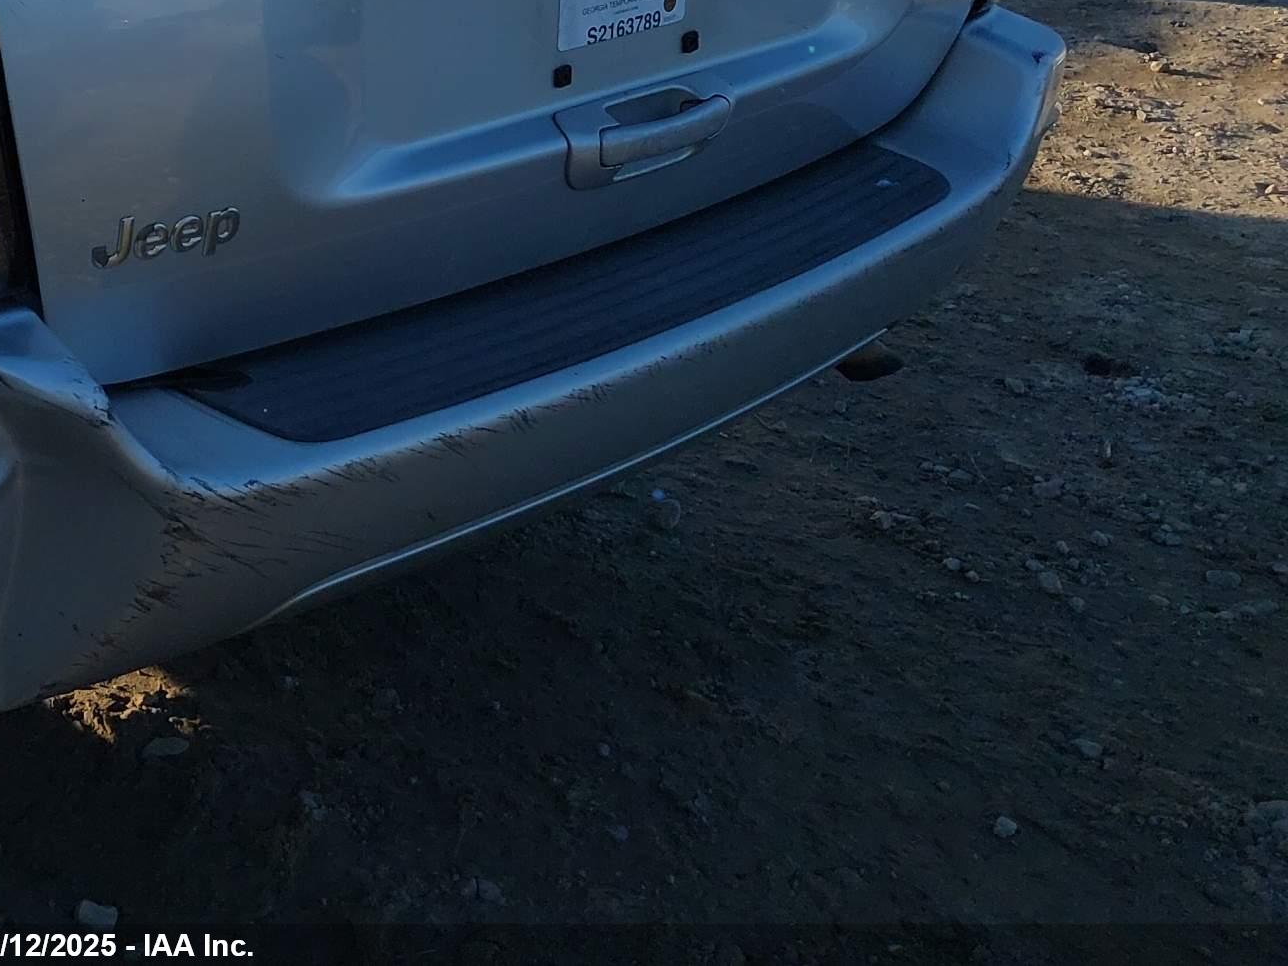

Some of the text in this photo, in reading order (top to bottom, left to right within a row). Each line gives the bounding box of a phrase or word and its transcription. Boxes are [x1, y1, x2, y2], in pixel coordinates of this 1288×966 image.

[582, 2, 609, 16] GEORGIA
[587, 10, 661, 45] S2163789
[92, 206, 241, 268] Jeep
